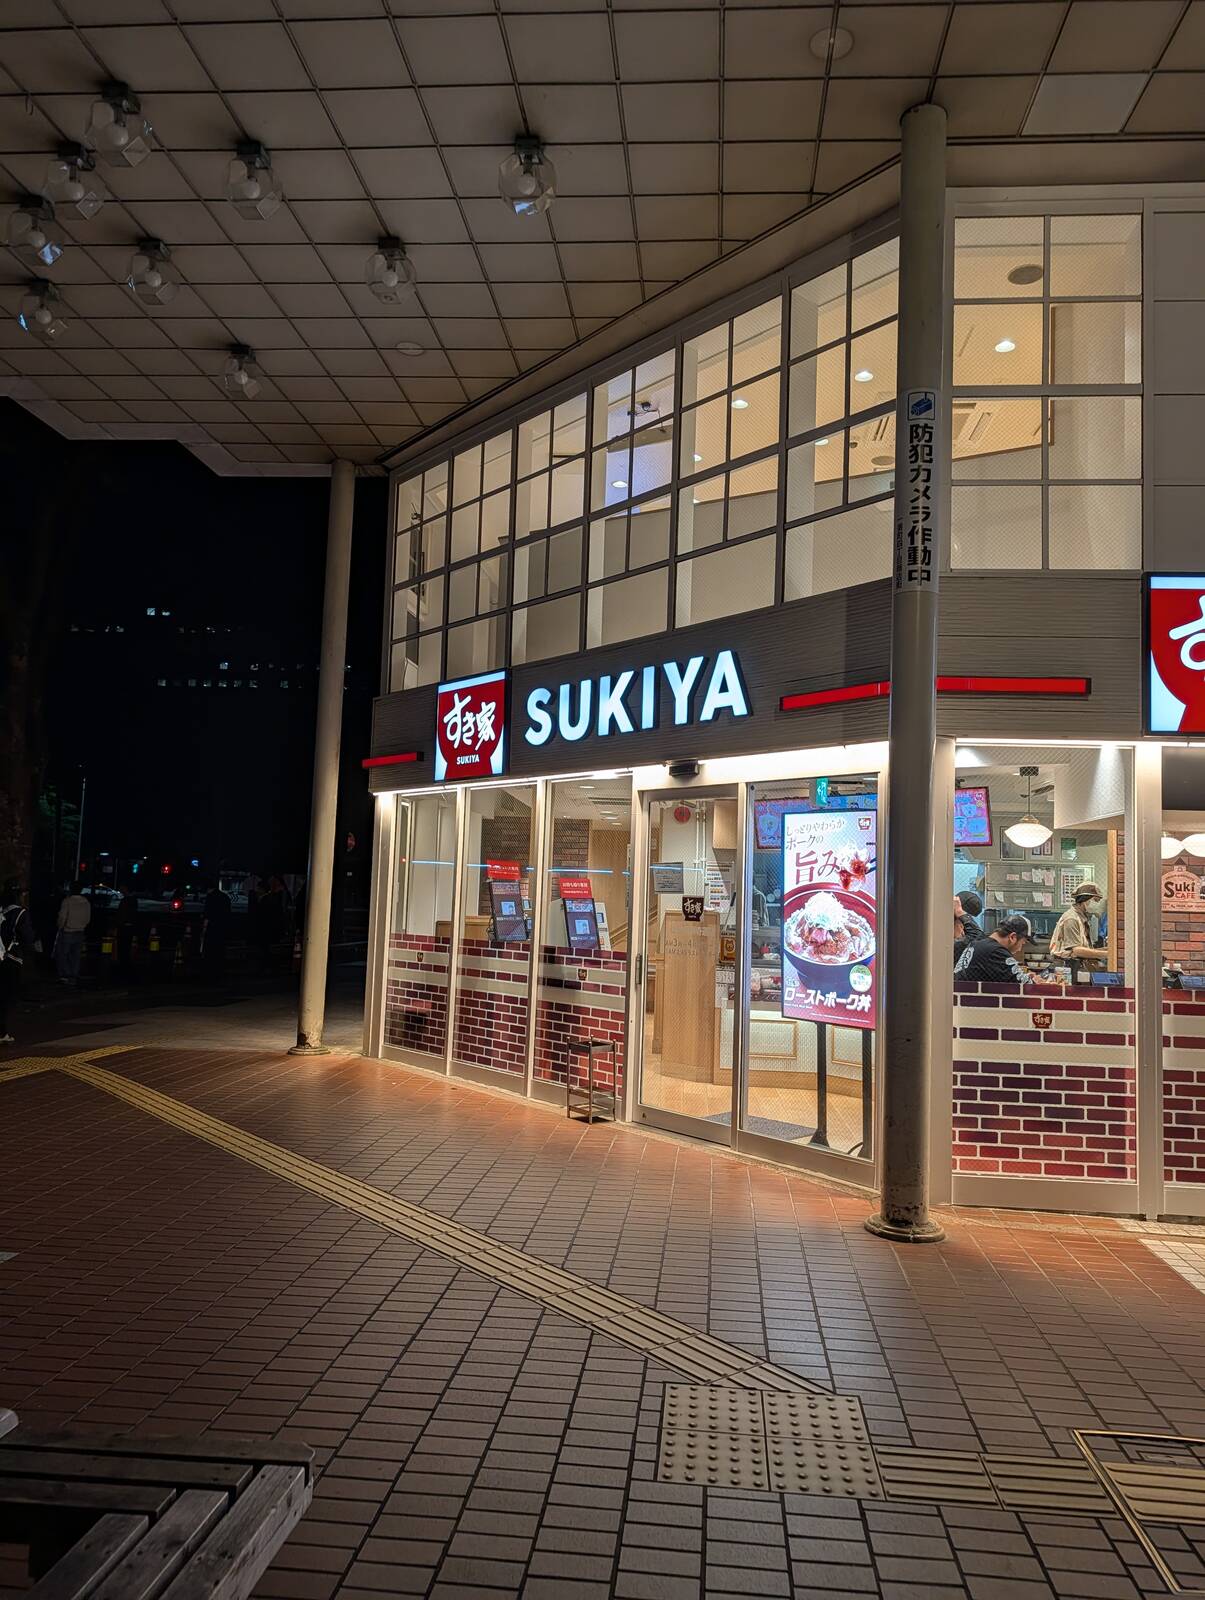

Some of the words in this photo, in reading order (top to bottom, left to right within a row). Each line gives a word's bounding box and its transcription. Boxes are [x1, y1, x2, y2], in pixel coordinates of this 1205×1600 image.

[907, 424, 933, 586] 防犯カメラ作動中
[524, 650, 749, 746] SUKIYA
[443, 692, 496, 751] すき家
[456, 754, 480, 765] SUKIYA
[1164, 881, 1195, 898] Suki
[684, 898, 702, 914] すき家
[784, 988, 872, 1012] ローストポーク丼
